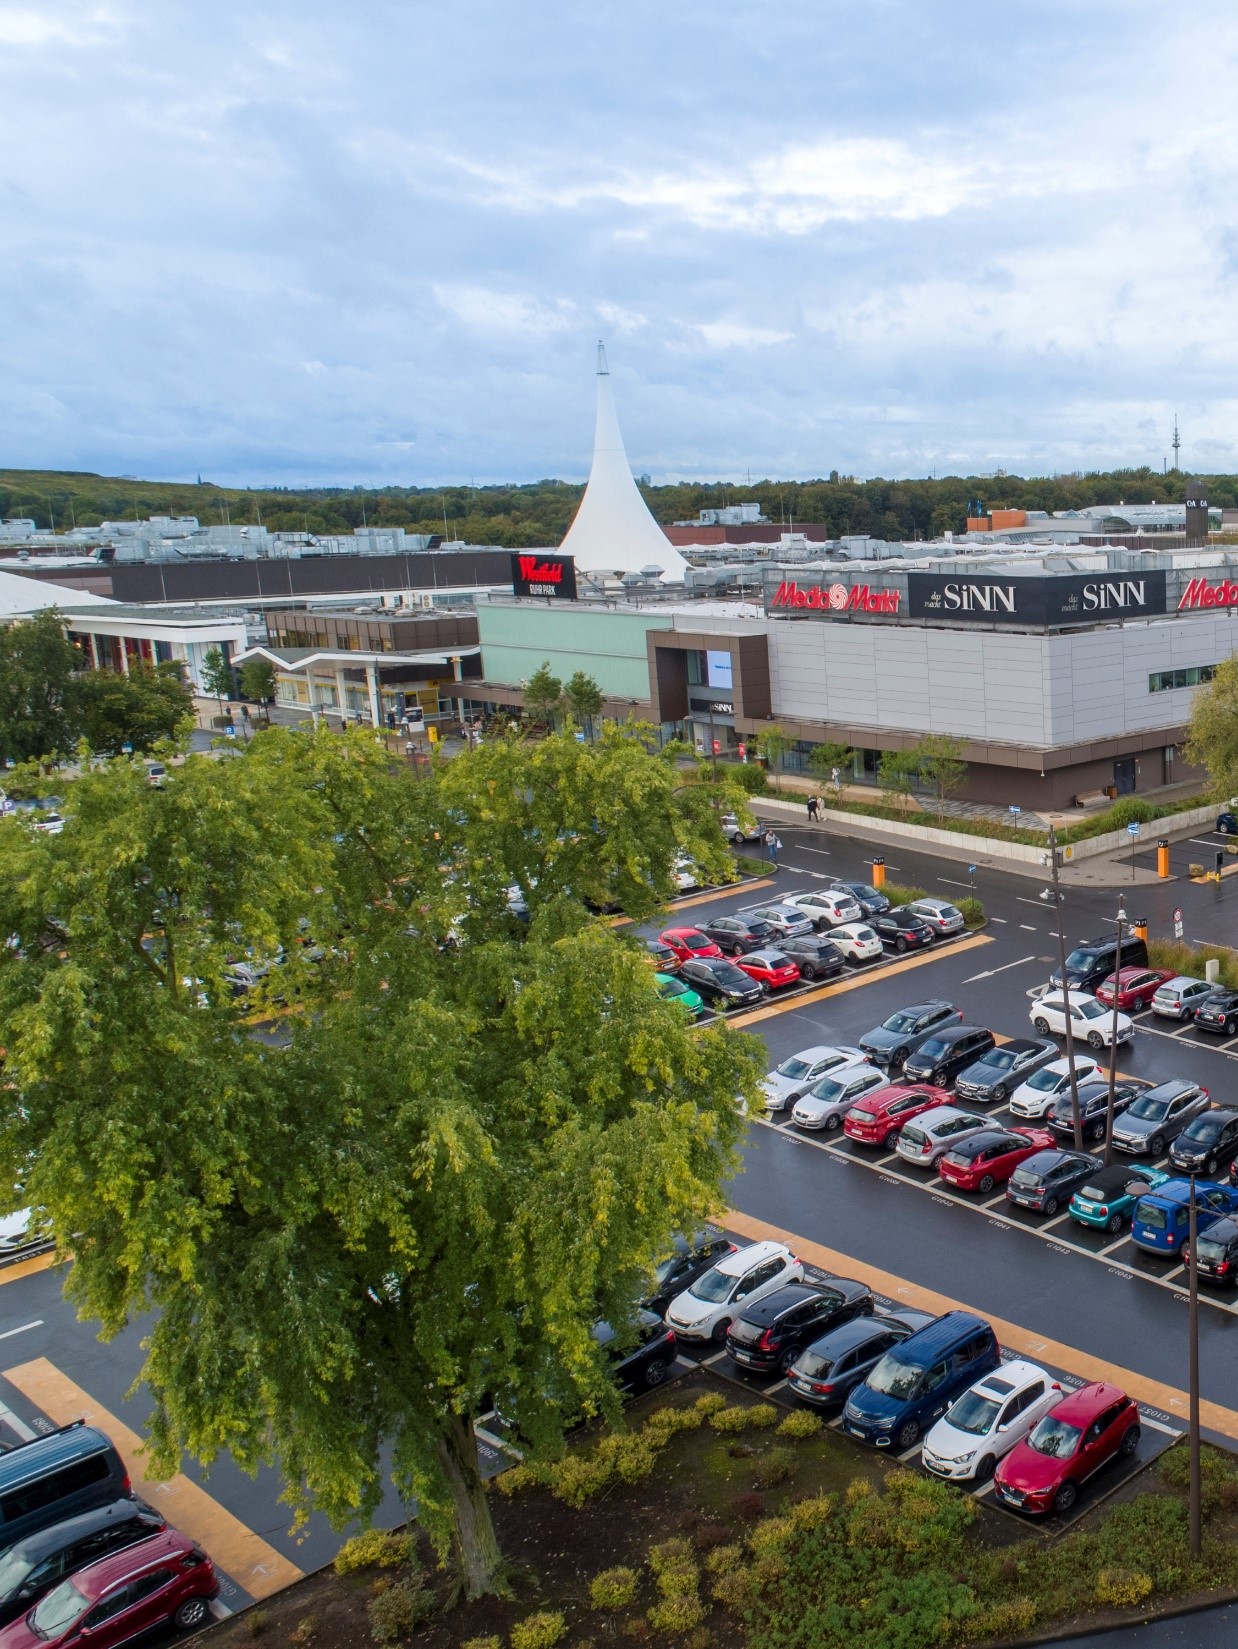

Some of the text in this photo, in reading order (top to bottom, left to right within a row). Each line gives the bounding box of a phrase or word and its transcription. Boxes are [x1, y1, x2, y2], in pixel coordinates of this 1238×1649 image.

[519, 556, 563, 582] Westfield
[529, 584, 556, 596] RUHR PARK
[1082, 580, 1147, 611] SiNN
[770, 581, 901, 613] Media Markt
[943, 583, 1017, 612] SiNN
[4, 801, 13, 810] P
[931, 1195, 954, 1207] G1040
[988, 1219, 1011, 1230] G1041
[1046, 1242, 1071, 1255] G1042
[1107, 1267, 1133, 1280] G1043
[1173, 1293, 1199, 1304] G10
[1142, 1406, 1170, 1421] G1057
